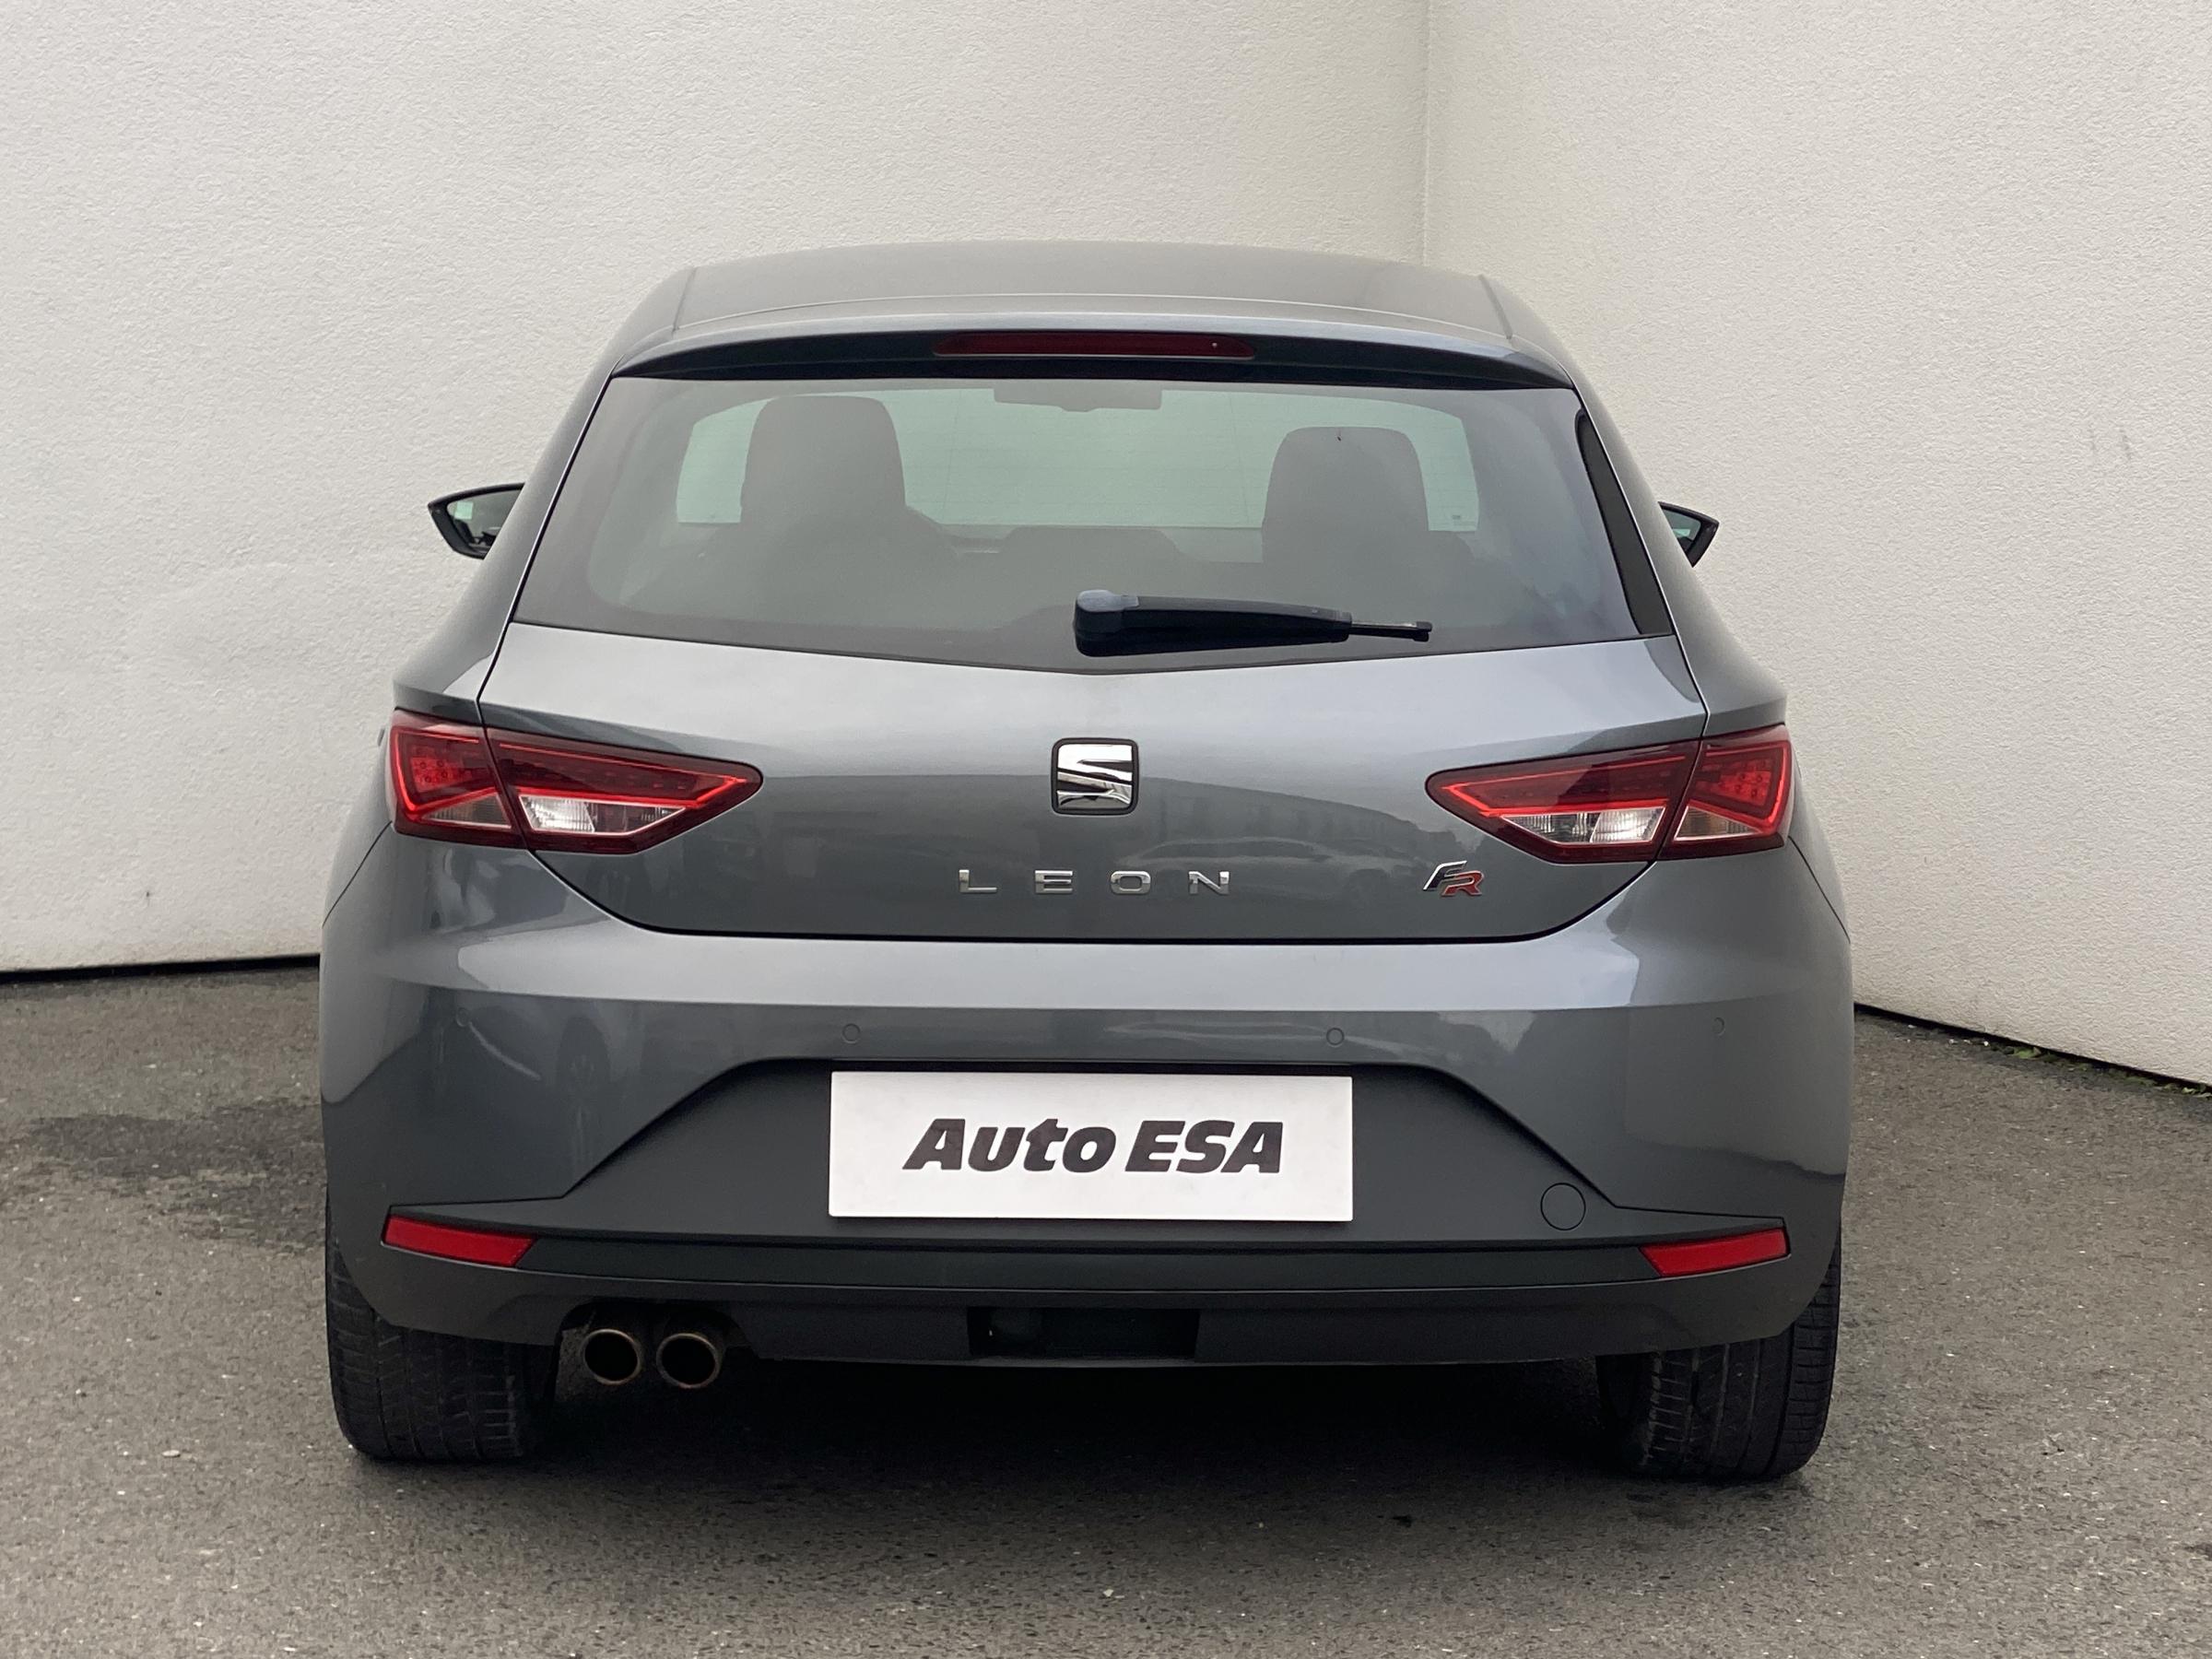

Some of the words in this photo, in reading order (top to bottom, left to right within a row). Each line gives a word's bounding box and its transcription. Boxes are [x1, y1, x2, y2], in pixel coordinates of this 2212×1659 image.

[959, 869, 1230, 895] LEON
[1422, 860, 1484, 897] FR
[902, 1118, 1117, 1173] Auto
[1124, 1120, 1284, 1173] ESA
